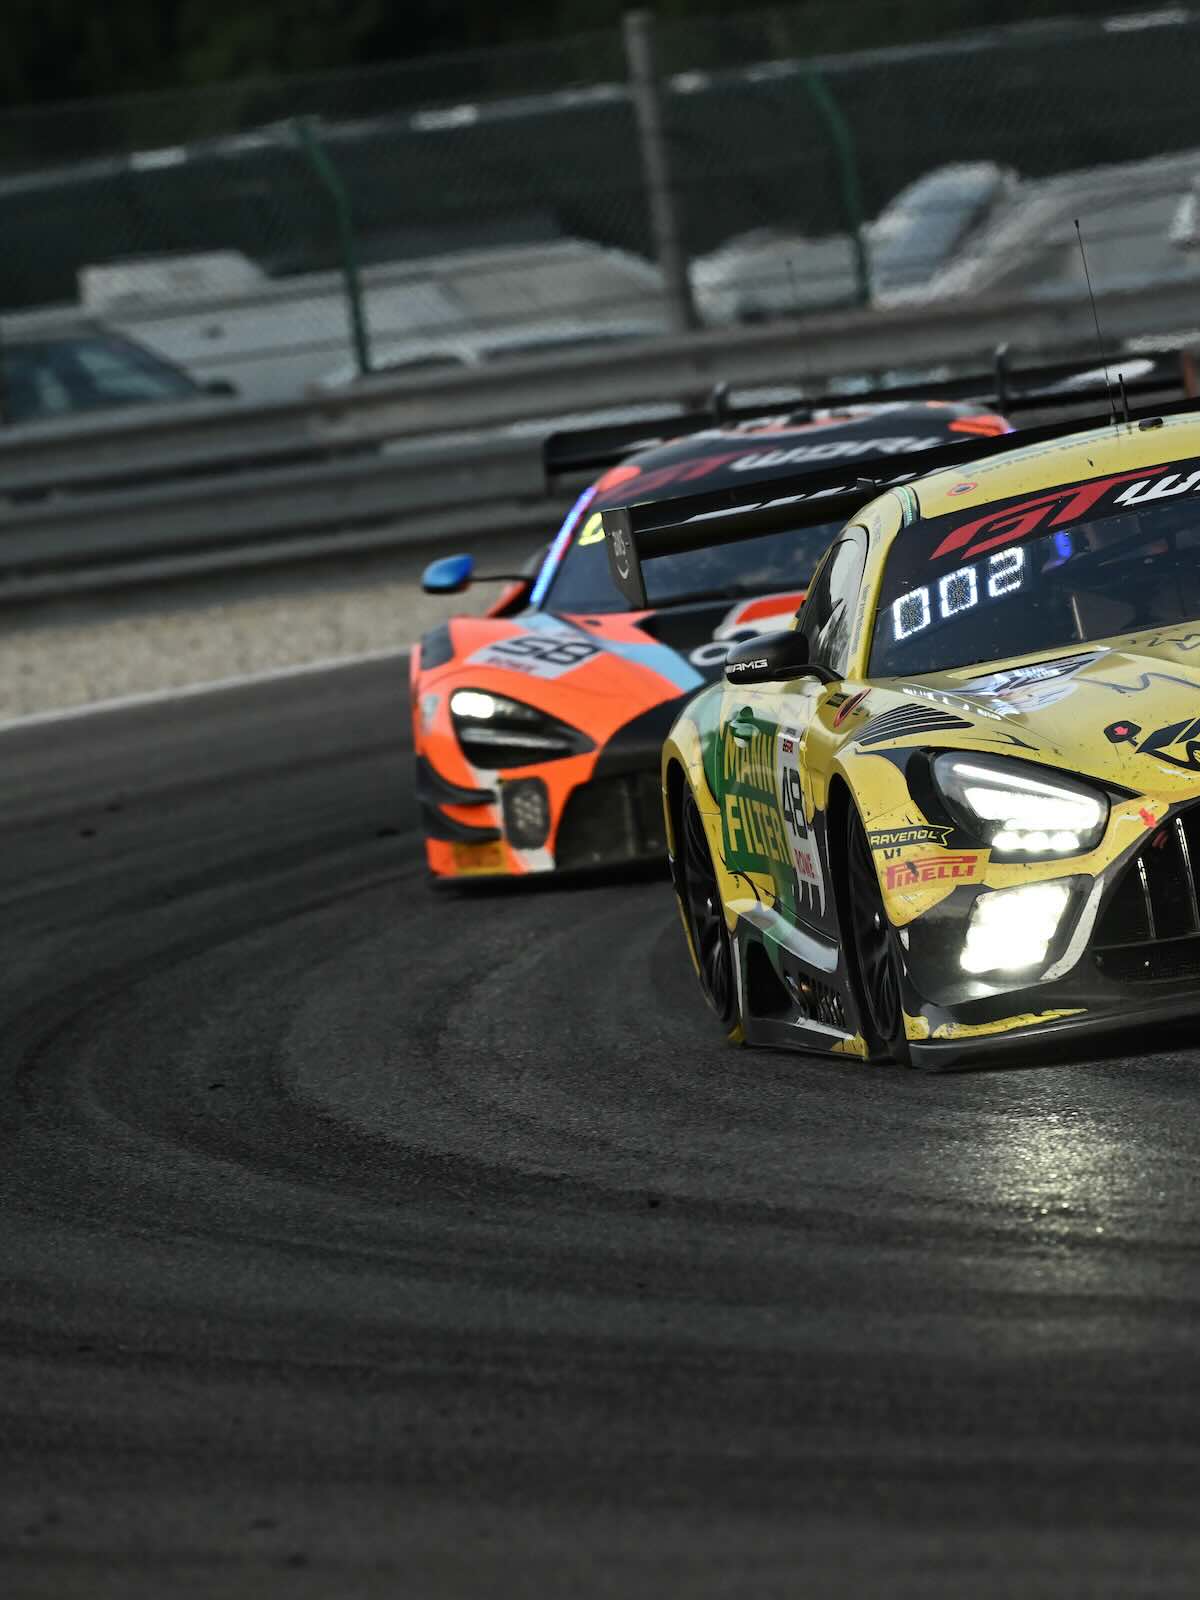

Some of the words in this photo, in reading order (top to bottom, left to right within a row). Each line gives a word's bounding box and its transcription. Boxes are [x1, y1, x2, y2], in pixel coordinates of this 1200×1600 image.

[929, 465, 1168, 560] GT
[893, 547, 1024, 641] 002
[491, 636, 601, 666] 58
[732, 658, 768, 673] AMG
[724, 727, 776, 795] MANN
[782, 766, 809, 840] 48
[725, 793, 791, 866] FILTER
[870, 829, 938, 846] RAVENOL
[883, 848, 902, 860] V1
[887, 855, 978, 890] PIRELLI
